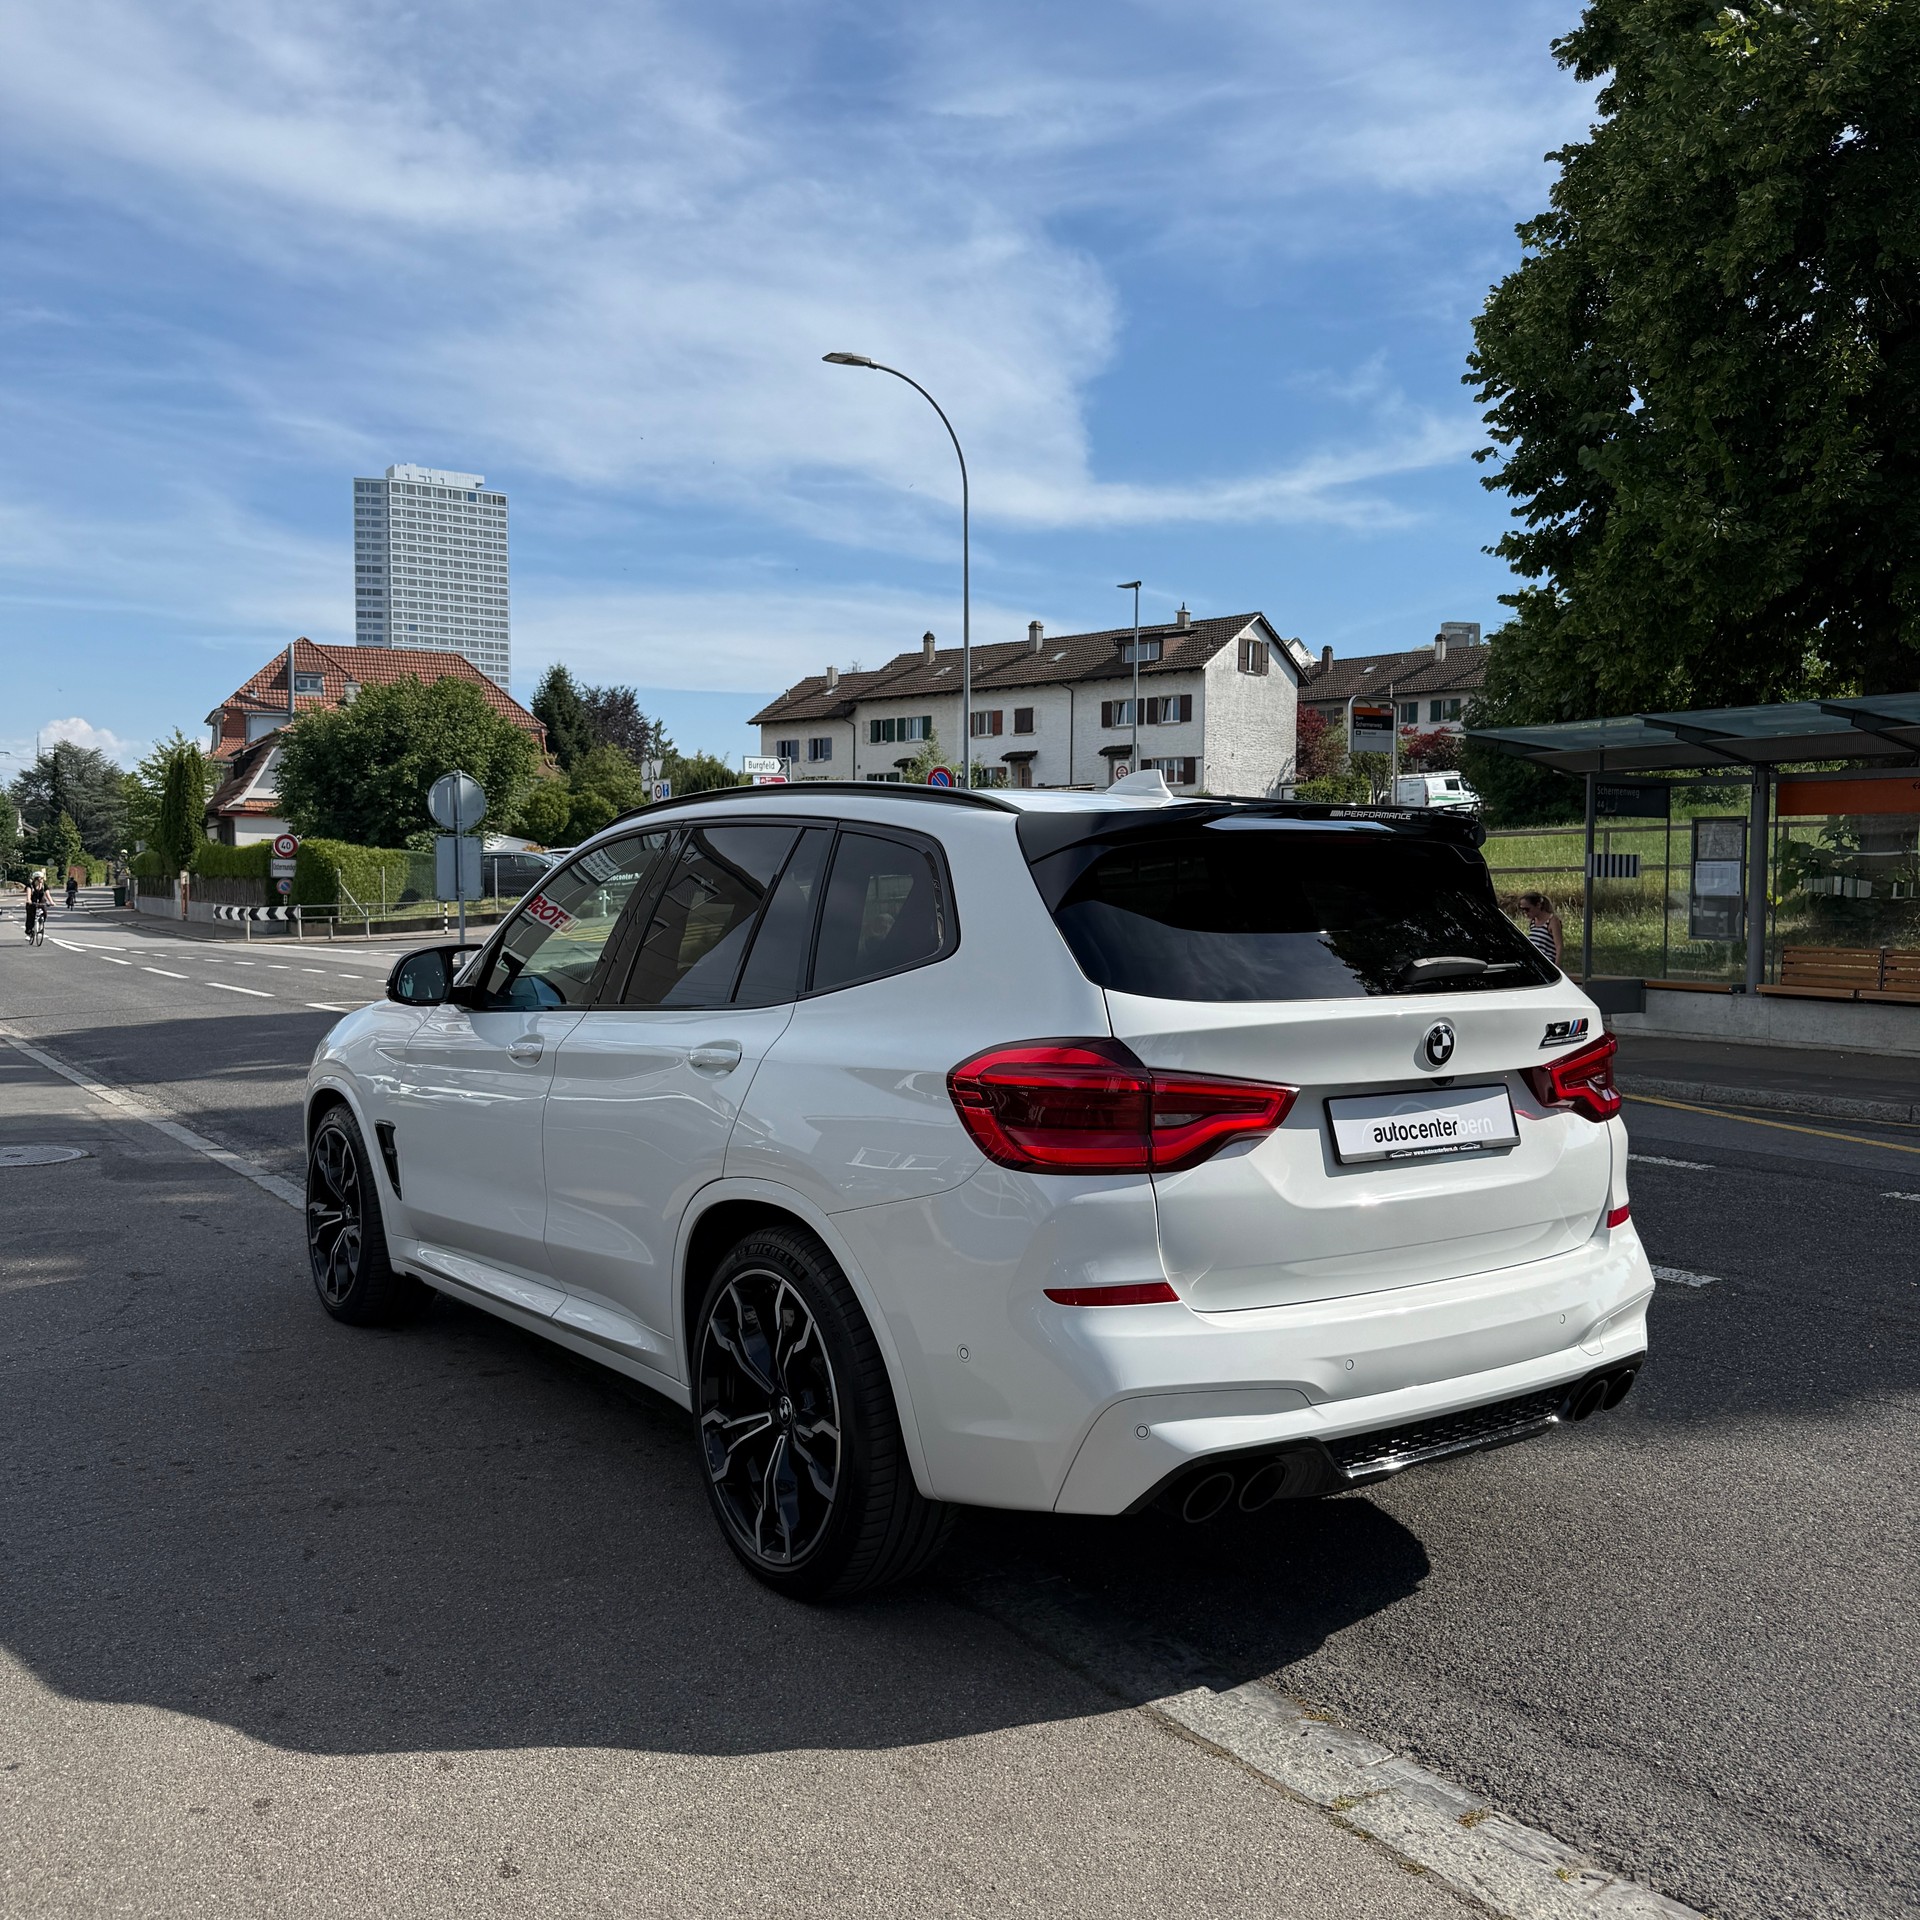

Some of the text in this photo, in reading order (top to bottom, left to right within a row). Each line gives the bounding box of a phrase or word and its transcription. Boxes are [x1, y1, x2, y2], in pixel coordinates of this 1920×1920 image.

[748, 760, 775, 771] Burgfeld
[1596, 785, 1641, 799] Schermenweg
[1596, 800, 1605, 808] 44
[281, 841, 291, 849] 40
[747, 1243, 806, 1279] MICHELIN
